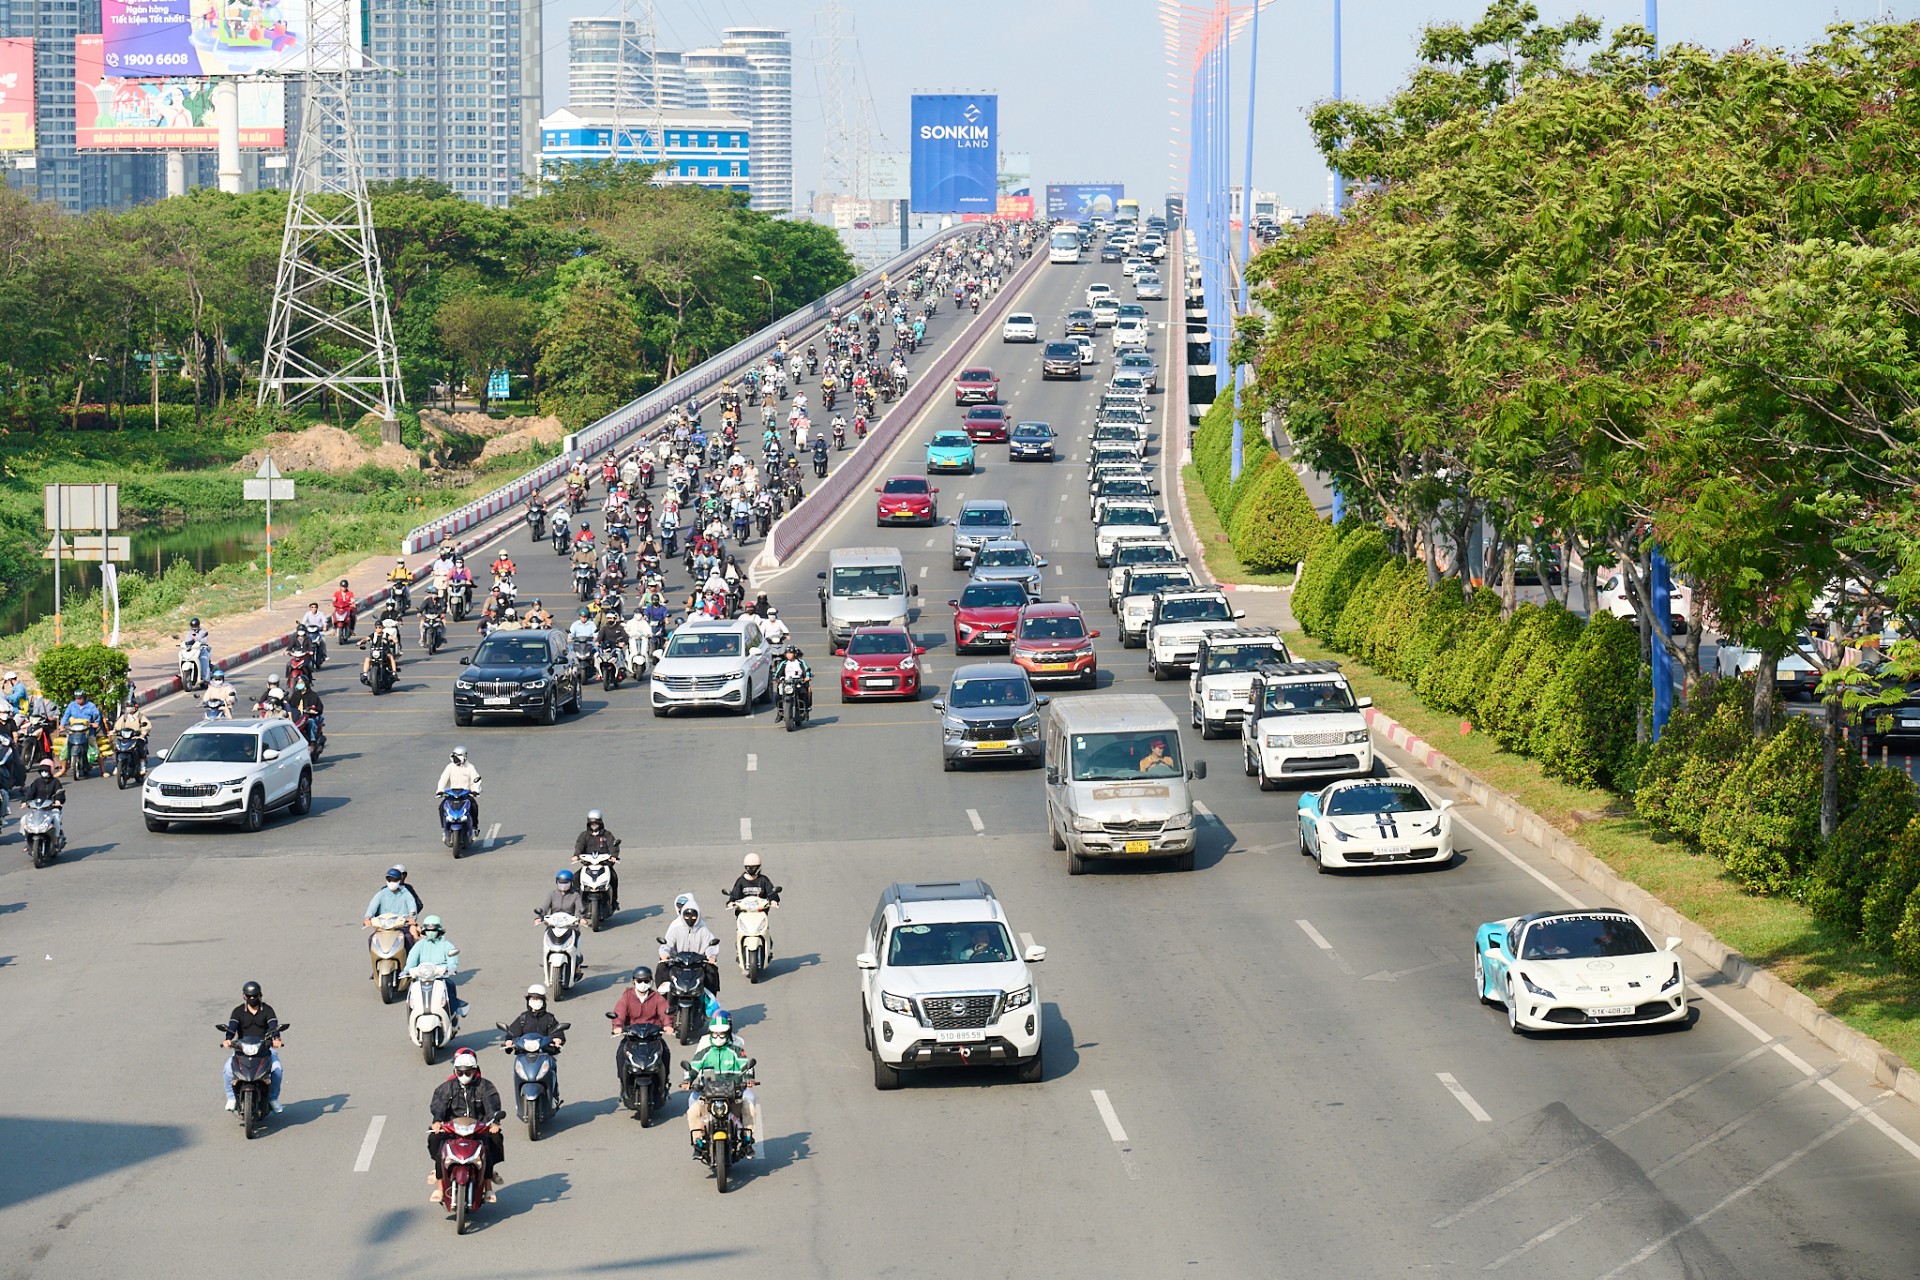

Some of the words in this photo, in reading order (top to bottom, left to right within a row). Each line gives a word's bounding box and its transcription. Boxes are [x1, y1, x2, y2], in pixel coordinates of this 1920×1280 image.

[148, 5, 169, 14] hàng
[124, 54, 154, 65] 1900
[156, 54, 188, 65] 6608
[920, 125, 988, 139] SONKIM
[958, 140, 988, 148] LAND
[1539, 918, 1558, 926] THE
[1589, 915, 1631, 923] COFFEE!
